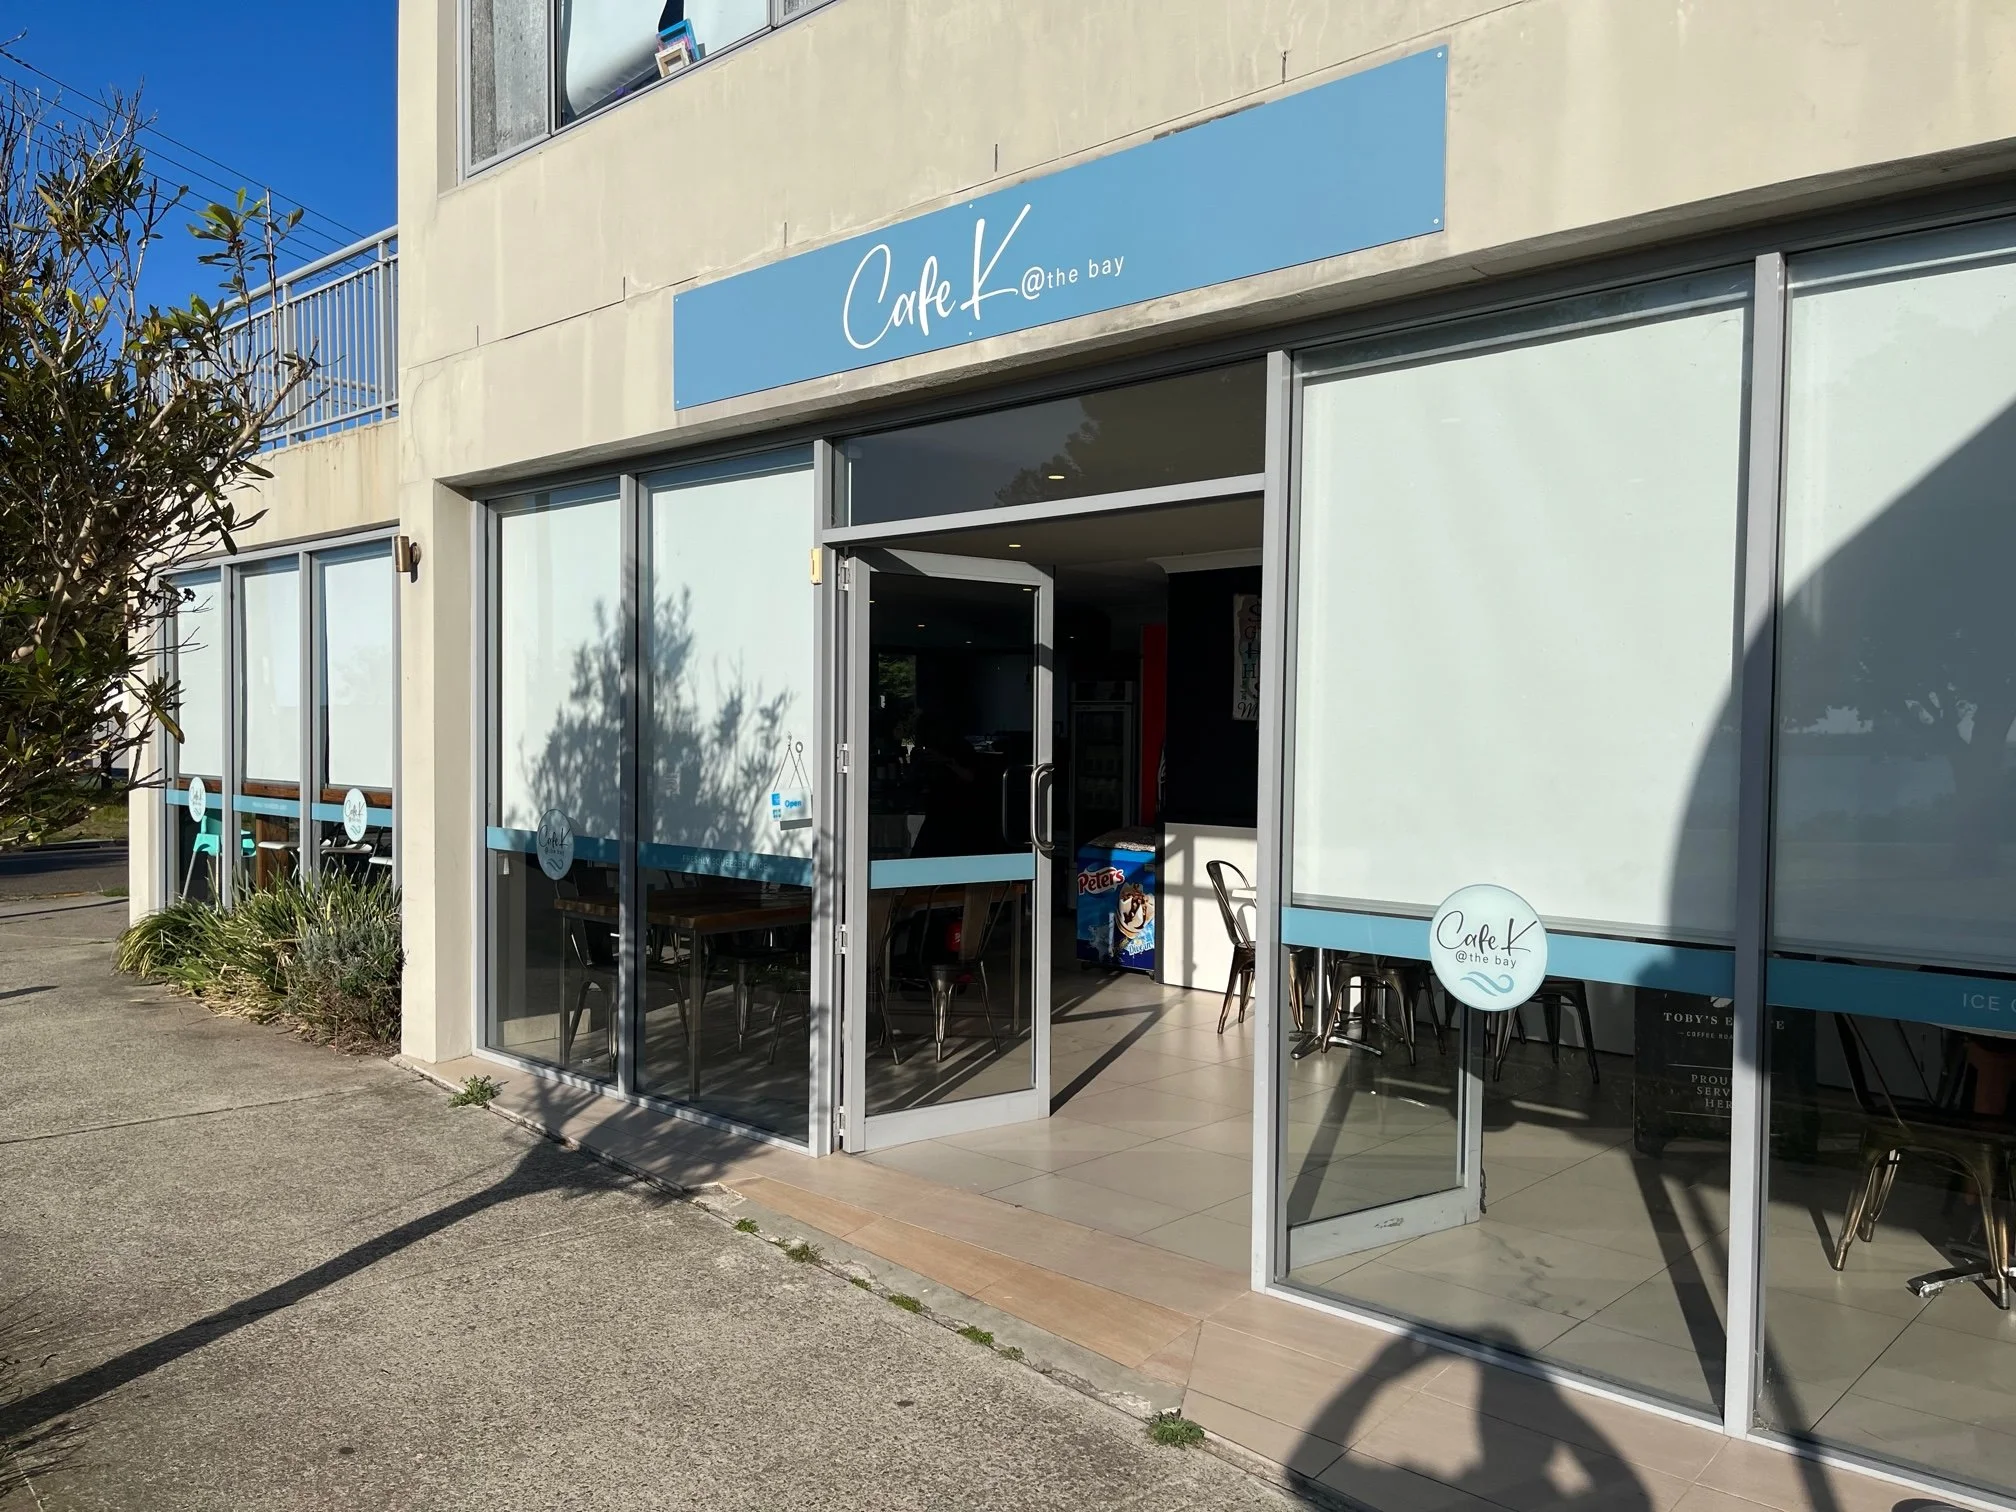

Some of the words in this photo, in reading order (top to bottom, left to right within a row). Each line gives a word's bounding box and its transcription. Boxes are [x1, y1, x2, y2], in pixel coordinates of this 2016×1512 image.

[843, 244, 956, 349] Cafe
[960, 203, 1031, 321] K
[1021, 266, 1079, 300] @the
[1088, 255, 1125, 278] bay
[784, 800, 802, 809] Open
[559, 828, 571, 849] K
[1078, 868, 1124, 894] Peters
[1436, 910, 1499, 954] Cafe
[1500, 918, 1538, 956] K
[1455, 950, 1489, 964] @the
[1495, 956, 1517, 969] bay
[1962, 993, 2000, 1012] ICE
[1663, 1012, 1718, 1025] TOBY'S
[1686, 1031, 1715, 1039] COFFEE
[1691, 1074, 1732, 1086] PROU
[1696, 1086, 1732, 1097] SERV
[1704, 1098, 1732, 1109] HER
